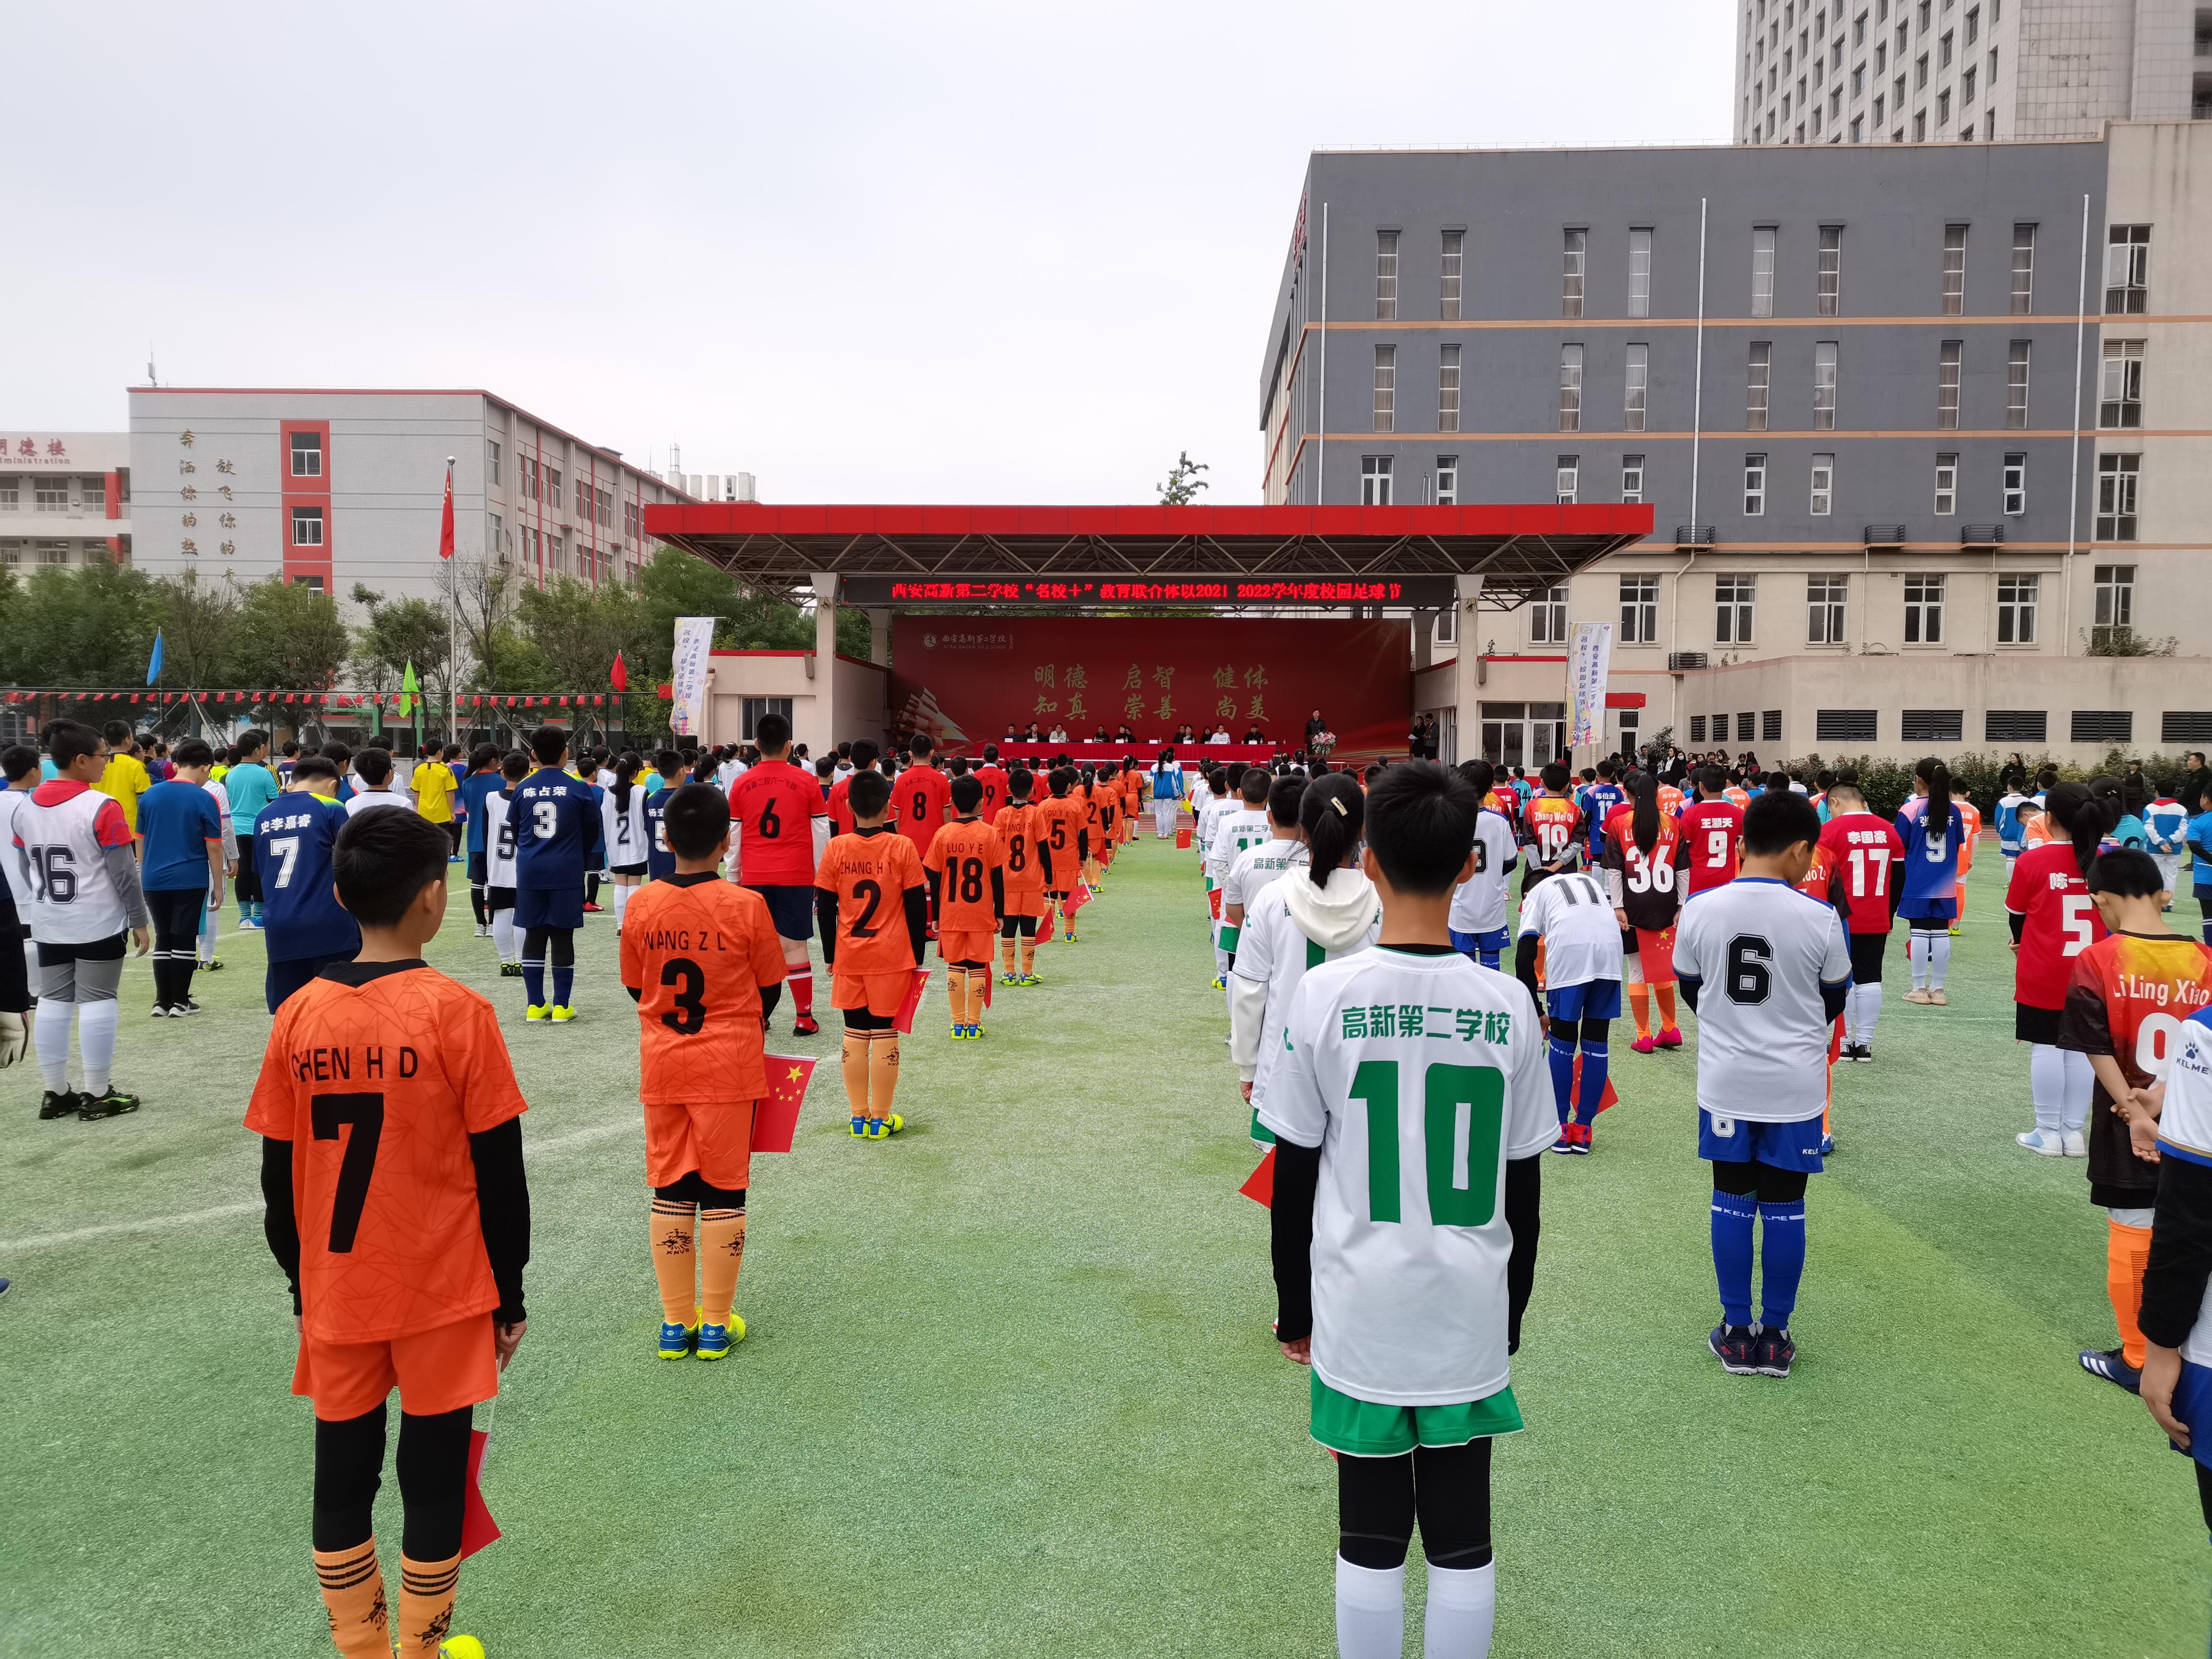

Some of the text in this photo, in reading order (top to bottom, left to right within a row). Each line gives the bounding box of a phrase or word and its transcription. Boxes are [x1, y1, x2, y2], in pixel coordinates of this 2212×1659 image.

[1034, 663, 1088, 689] 明德
[1122, 663, 1175, 691] 启智
[1215, 693, 1270, 722] 尚美
[523, 786, 567, 798] 陈占荣
[913, 792, 926, 821] 8
[985, 785, 995, 806] 9
[260, 814, 311, 836] 史李嘉睿
[533, 801, 557, 838] 3
[616, 814, 630, 846] 2
[759, 797, 780, 839] 6
[1087, 802, 1097, 824] 2
[1535, 812, 1553, 823] Zhang
[1554, 812, 1567, 821] Wei
[496, 823, 517, 861] 5
[947, 842, 983, 854] LUO Y E
[1050, 818, 1066, 850] 5
[1538, 823, 1568, 861] 19
[1707, 831, 1728, 867] 9
[1847, 830, 1887, 844] 李国豪
[1926, 830, 1946, 862] 9
[270, 836, 299, 888] 7
[841, 861, 872, 875] ZHANG
[877, 862, 883, 875] H
[1009, 834, 1025, 872] 8
[1625, 845, 1674, 893] 36
[29, 844, 78, 904] 16
[946, 856, 983, 903] 18
[1847, 848, 1890, 897] 17
[2049, 872, 2089, 890] 陈一
[850, 879, 881, 938] 2
[1551, 877, 1601, 907] 11
[643, 930, 726, 951] WANG Z L
[2062, 894, 2093, 957] 5
[1724, 933, 1774, 1006] 6
[661, 958, 707, 1035] 3
[2113, 974, 2210, 1007] Li Ling Xiao
[1342, 1004, 1511, 1046] 高新第二学校
[292, 1046, 418, 1082] CHEN H D
[2176, 1057, 2210, 1075] KELME
[1348, 1060, 1505, 1227] 10
[311, 1092, 384, 1253] 7
